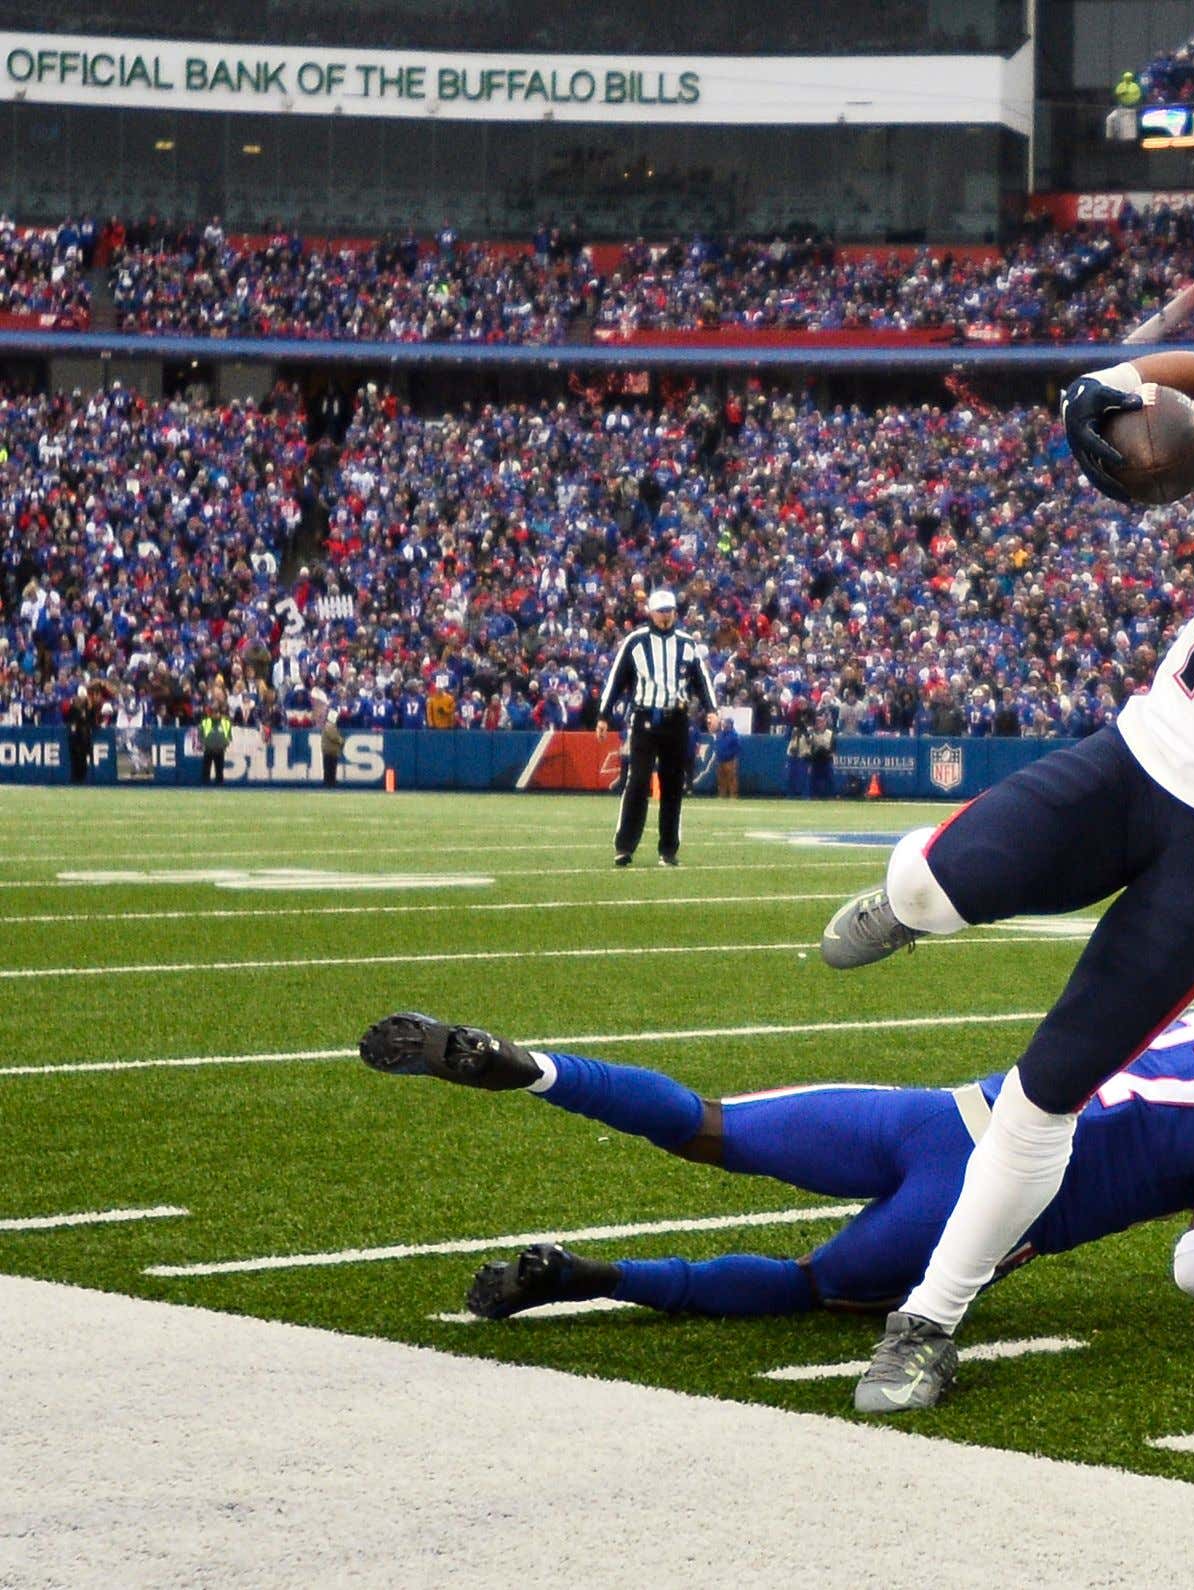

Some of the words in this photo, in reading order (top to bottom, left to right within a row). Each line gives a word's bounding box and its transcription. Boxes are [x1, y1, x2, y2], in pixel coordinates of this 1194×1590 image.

[6, 48, 174, 90] OFFICIAL
[186, 57, 288, 93] BANK
[297, 62, 346, 95] OF
[355, 65, 427, 99] THE
[437, 69, 597, 102] BUFFALO
[604, 70, 701, 104] BILLS
[1076, 194, 1124, 220] 227
[934, 763, 959, 785] NFL
